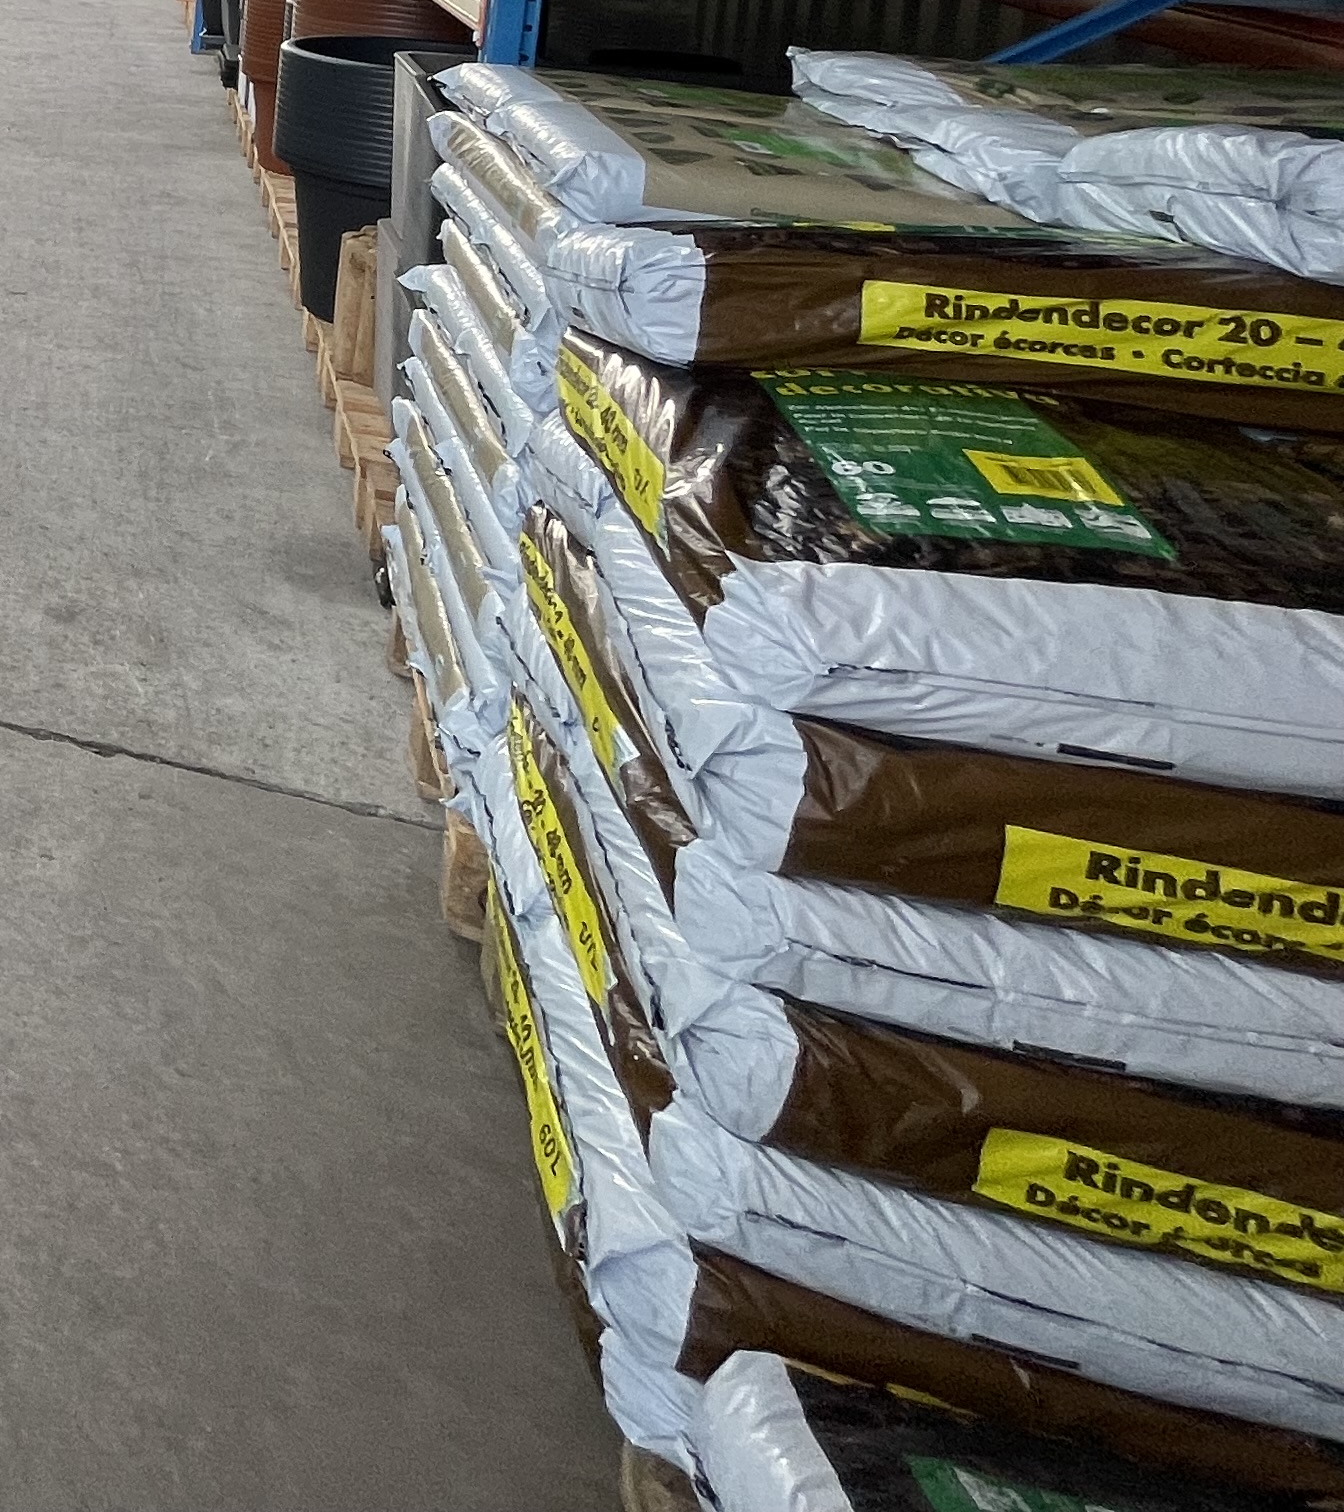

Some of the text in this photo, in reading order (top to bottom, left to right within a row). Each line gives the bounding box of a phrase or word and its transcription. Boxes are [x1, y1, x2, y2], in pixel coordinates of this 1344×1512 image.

[923, 292, 1282, 347] Rindendecor 20
[993, 328, 1117, 363] écorces
[1160, 347, 1326, 386] Corteccia
[1084, 850, 1344, 926] Rindend
